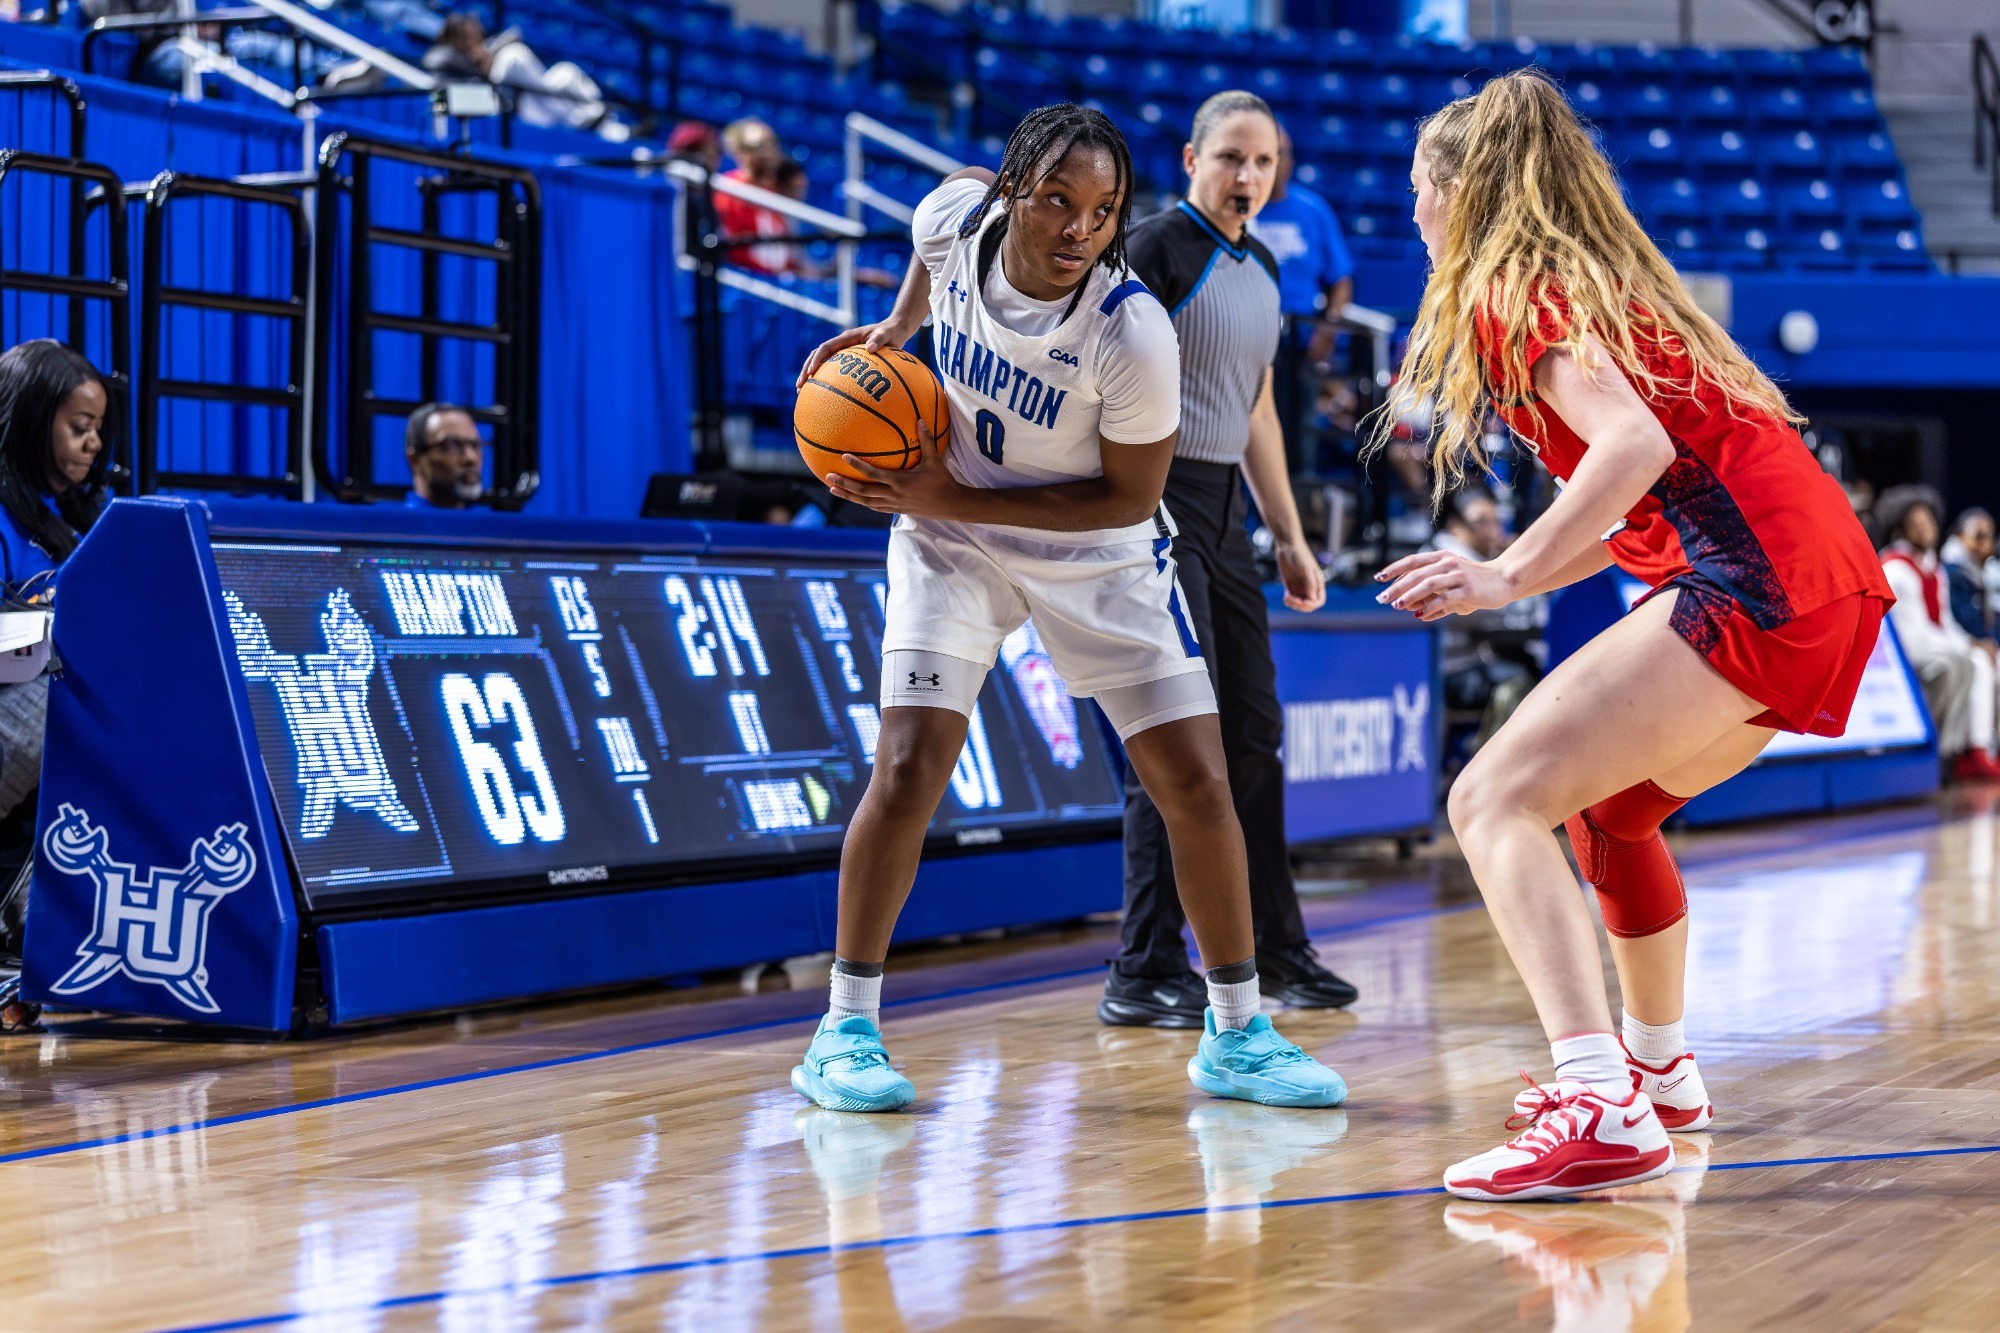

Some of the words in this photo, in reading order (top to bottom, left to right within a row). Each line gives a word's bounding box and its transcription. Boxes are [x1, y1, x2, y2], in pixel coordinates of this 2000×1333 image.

[822, 352, 893, 403] Wilso
[939, 320, 1067, 430] HAMPTON
[1048, 347, 1079, 368] CAA
[976, 407, 1006, 466] 0
[382, 572, 518, 635] HAMPTON
[664, 574, 771, 677] 2:14
[441, 672, 566, 845] 63
